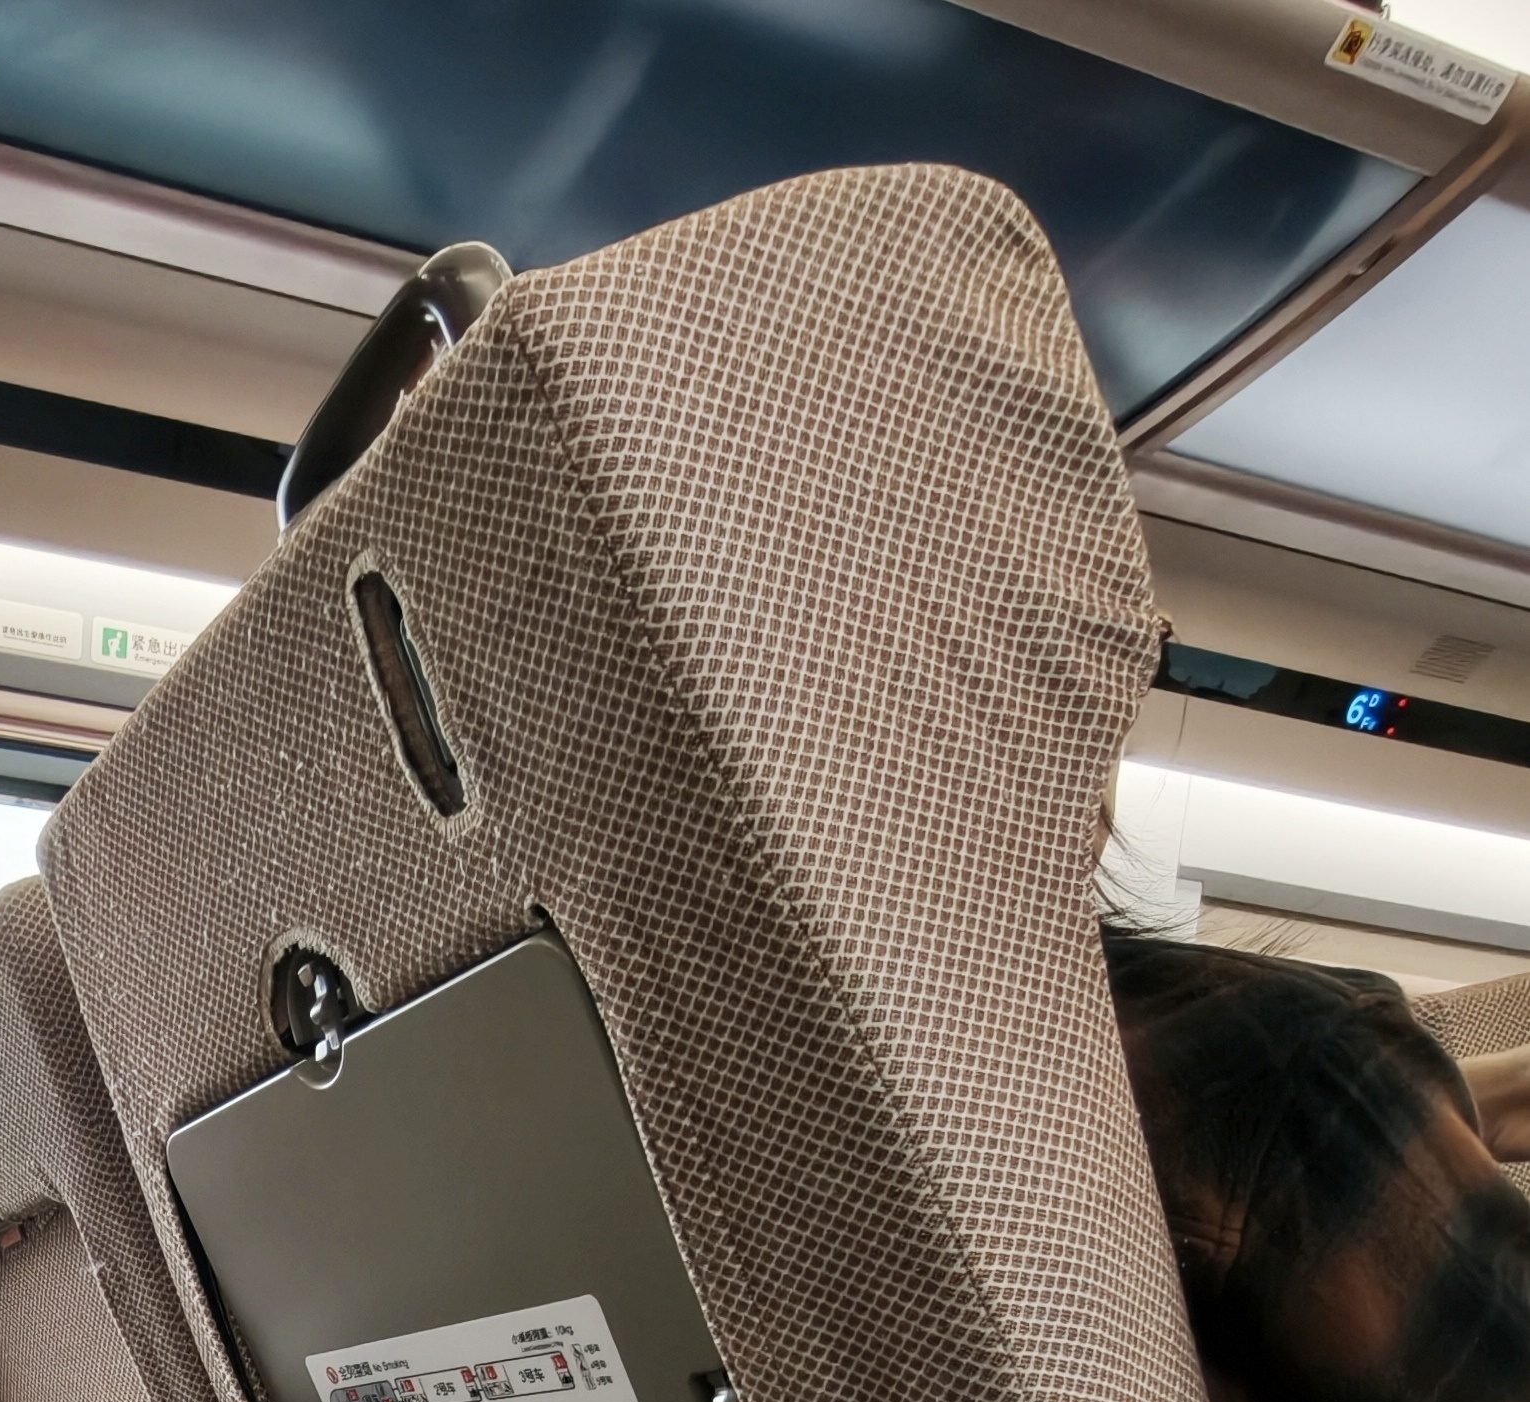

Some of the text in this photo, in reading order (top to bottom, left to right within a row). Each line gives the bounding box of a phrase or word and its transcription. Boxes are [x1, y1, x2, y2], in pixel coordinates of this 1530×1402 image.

[1347, 694, 1380, 724] 6 D
[518, 1367, 545, 1383] 3号车
